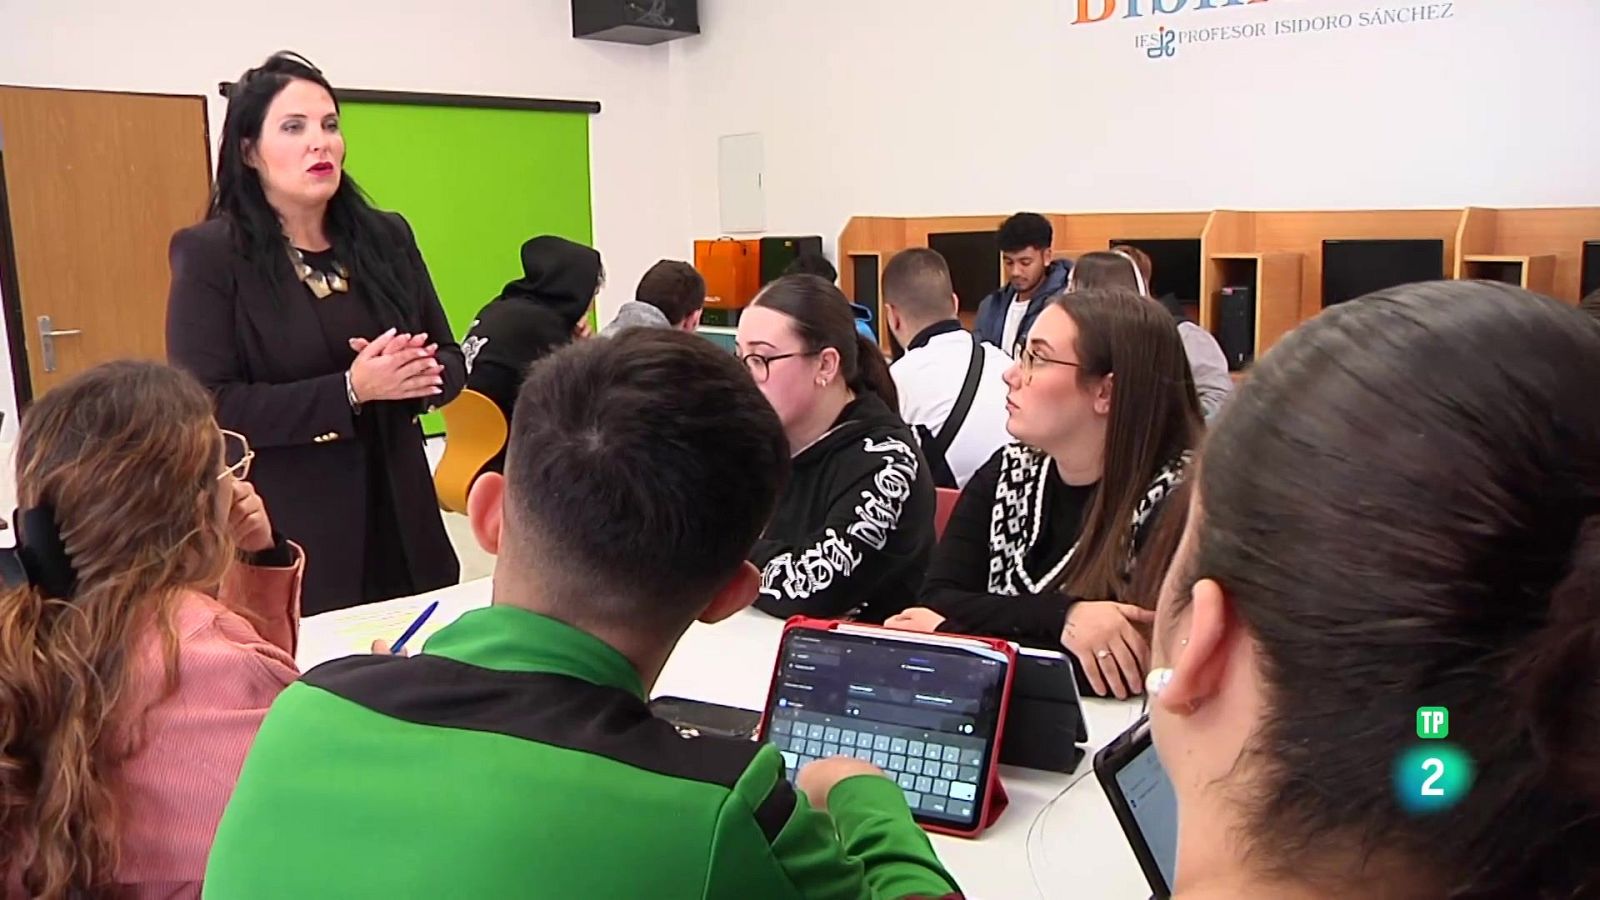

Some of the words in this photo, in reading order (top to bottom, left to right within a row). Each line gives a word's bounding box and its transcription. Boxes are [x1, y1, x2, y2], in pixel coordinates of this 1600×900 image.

[1135, 33, 1160, 48] IES
[1178, 22, 1266, 44] PROFESOR
[1275, 14, 1352, 35] ISIDORO
[1358, 2, 1454, 27] SÁNCHEZ
